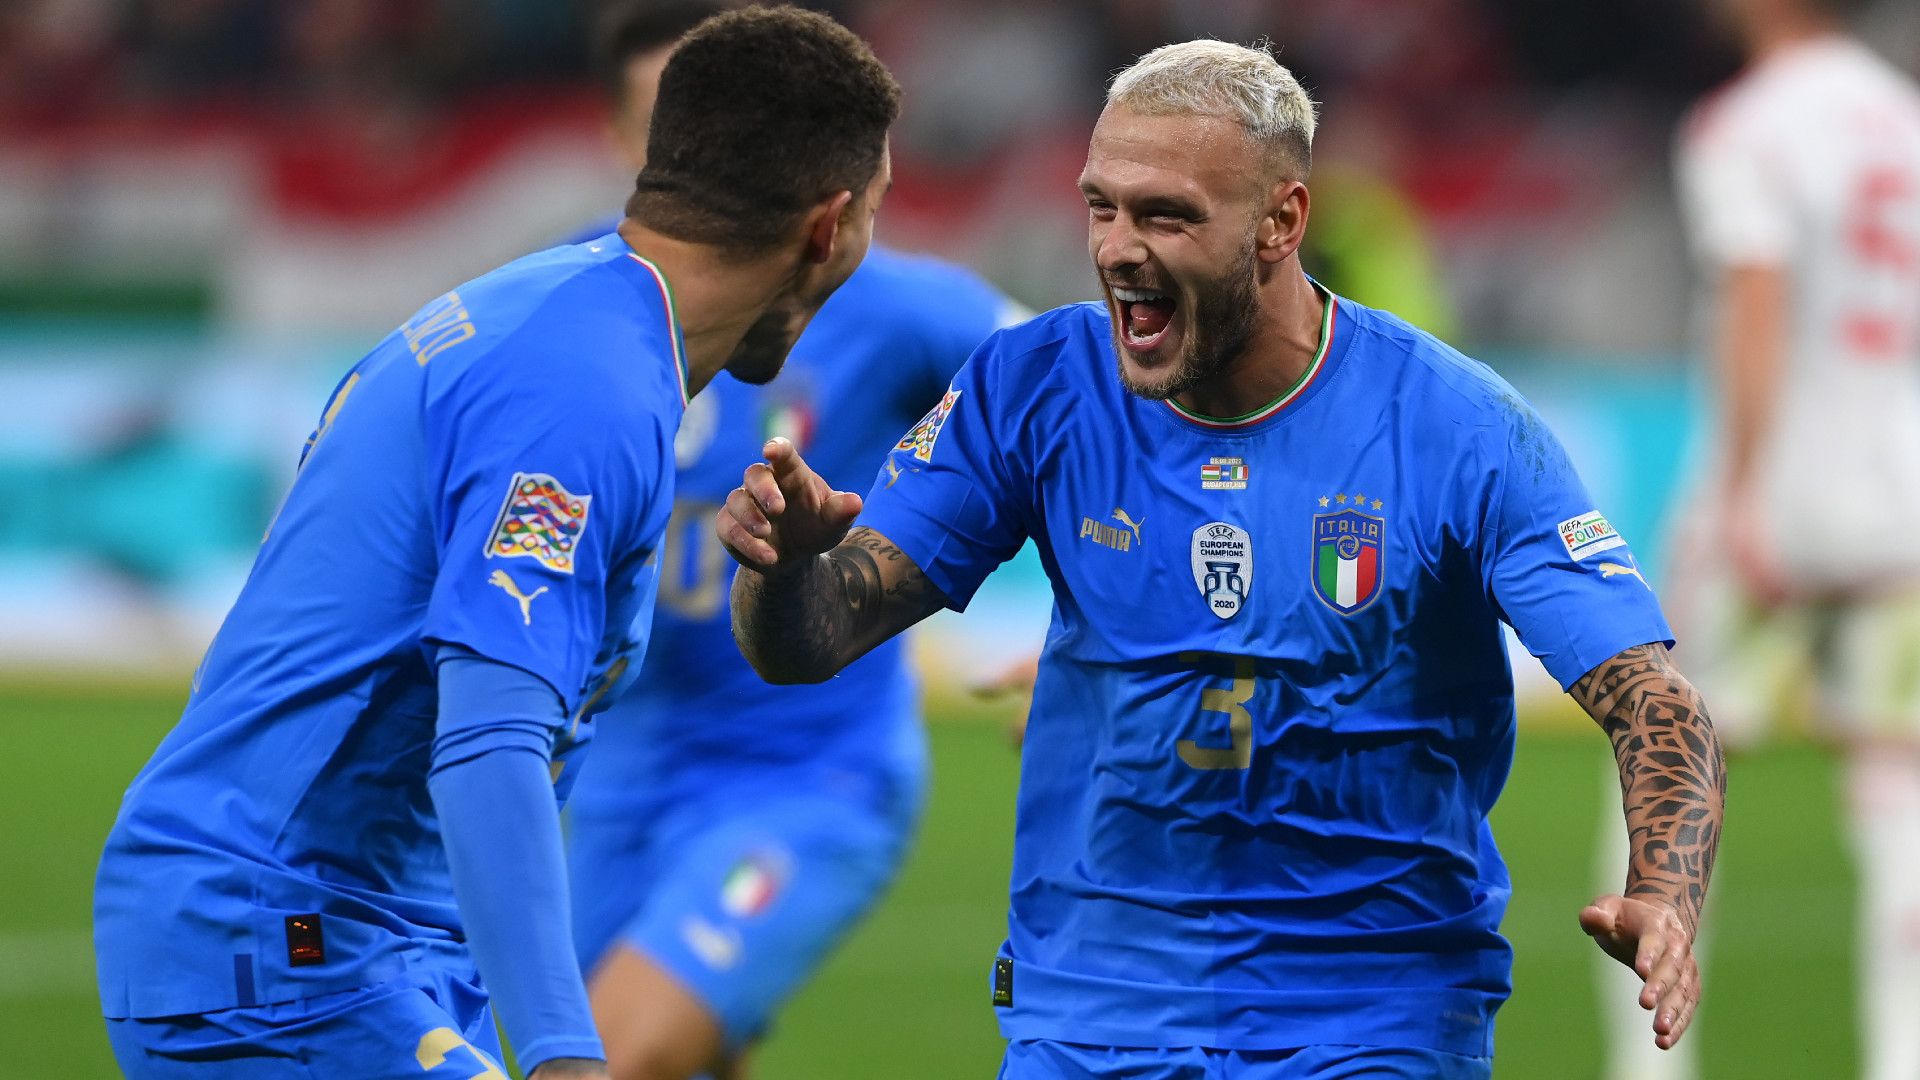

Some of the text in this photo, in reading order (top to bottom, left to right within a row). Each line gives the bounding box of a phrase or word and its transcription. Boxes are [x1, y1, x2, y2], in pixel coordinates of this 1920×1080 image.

[1208, 527, 1234, 538] UEFA
[1320, 520, 1378, 537] ITALIA
[1561, 520, 1581, 534] UEFA
[1080, 517, 1131, 552] PUMA
[1200, 540, 1244, 549] EUROPEAN
[1200, 549, 1244, 557] CHAMPIONS
[1214, 600, 1235, 608] 2020
[1176, 651, 1256, 770] 3
